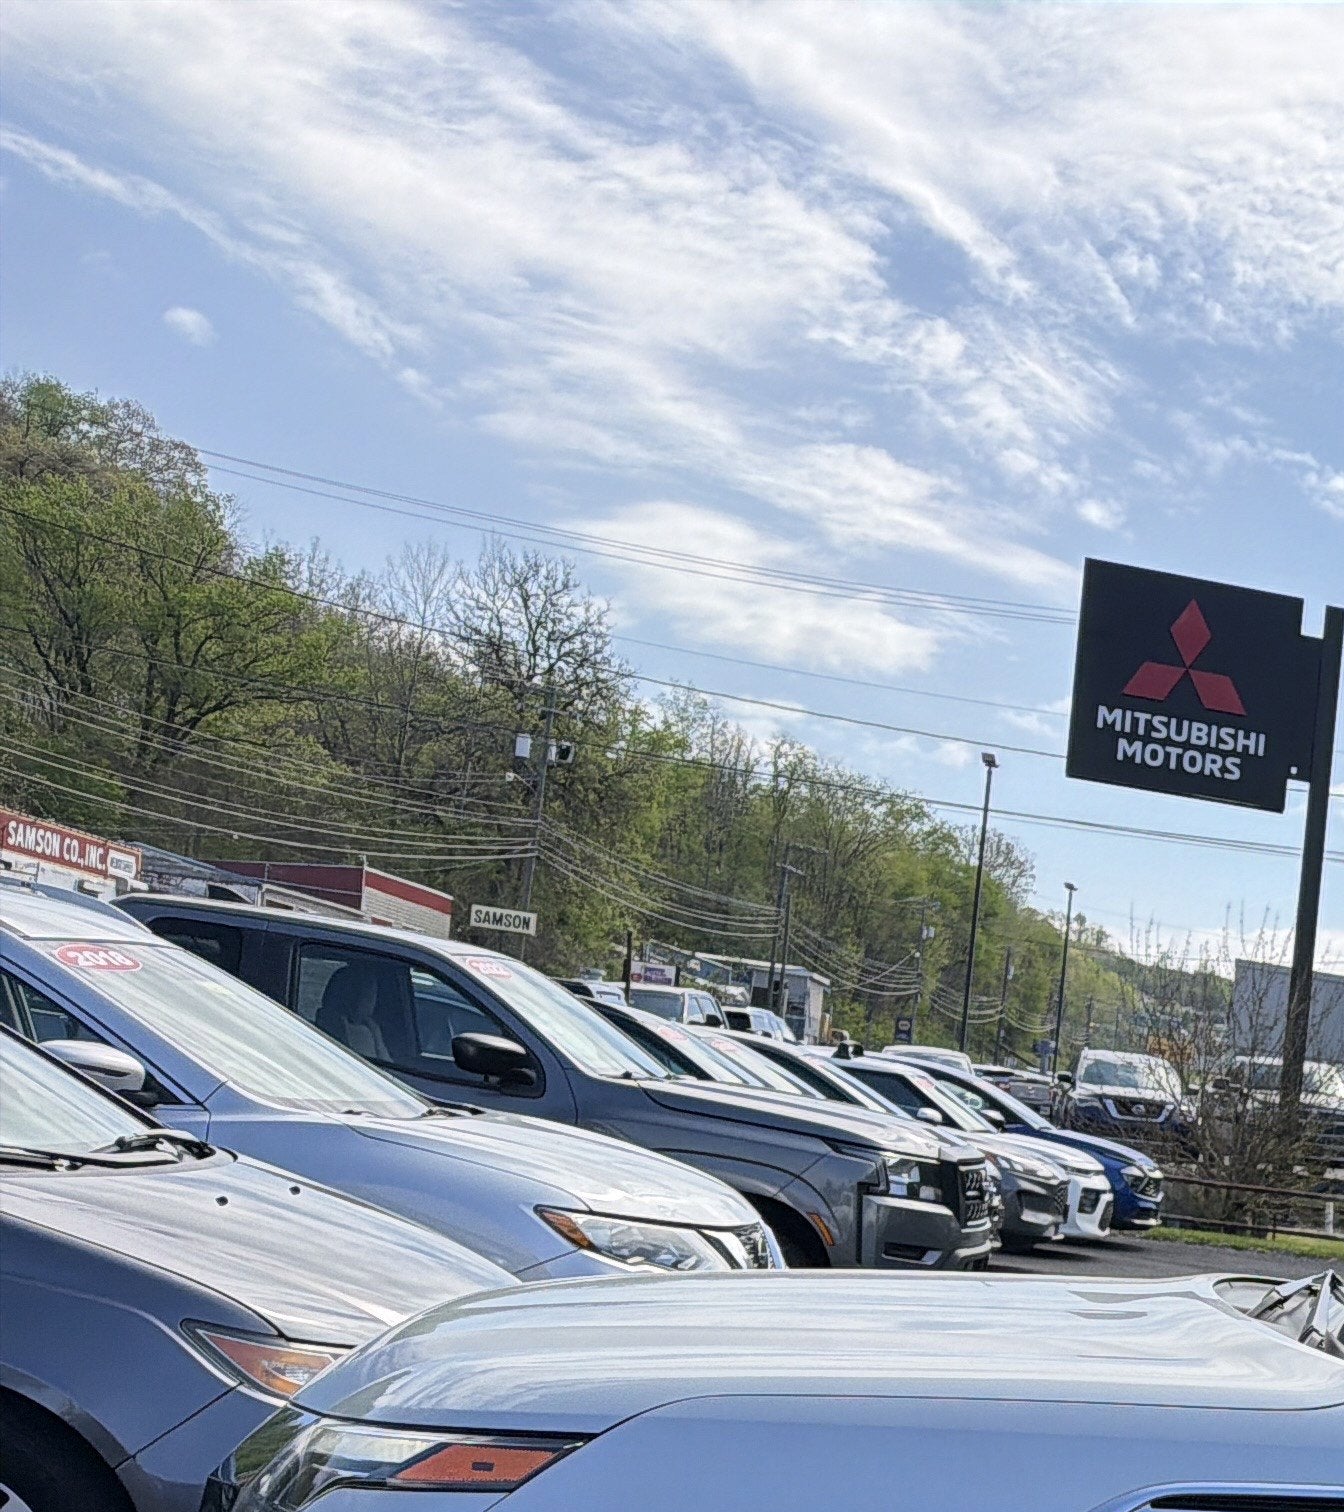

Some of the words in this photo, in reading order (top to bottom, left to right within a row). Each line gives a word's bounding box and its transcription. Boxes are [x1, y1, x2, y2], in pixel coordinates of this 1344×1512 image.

[1096, 704, 1266, 757] MITSUBISHI
[1116, 737, 1242, 781] MOTORS
[7, 820, 61, 858] SAMSON
[473, 909, 531, 931] SAMSON
